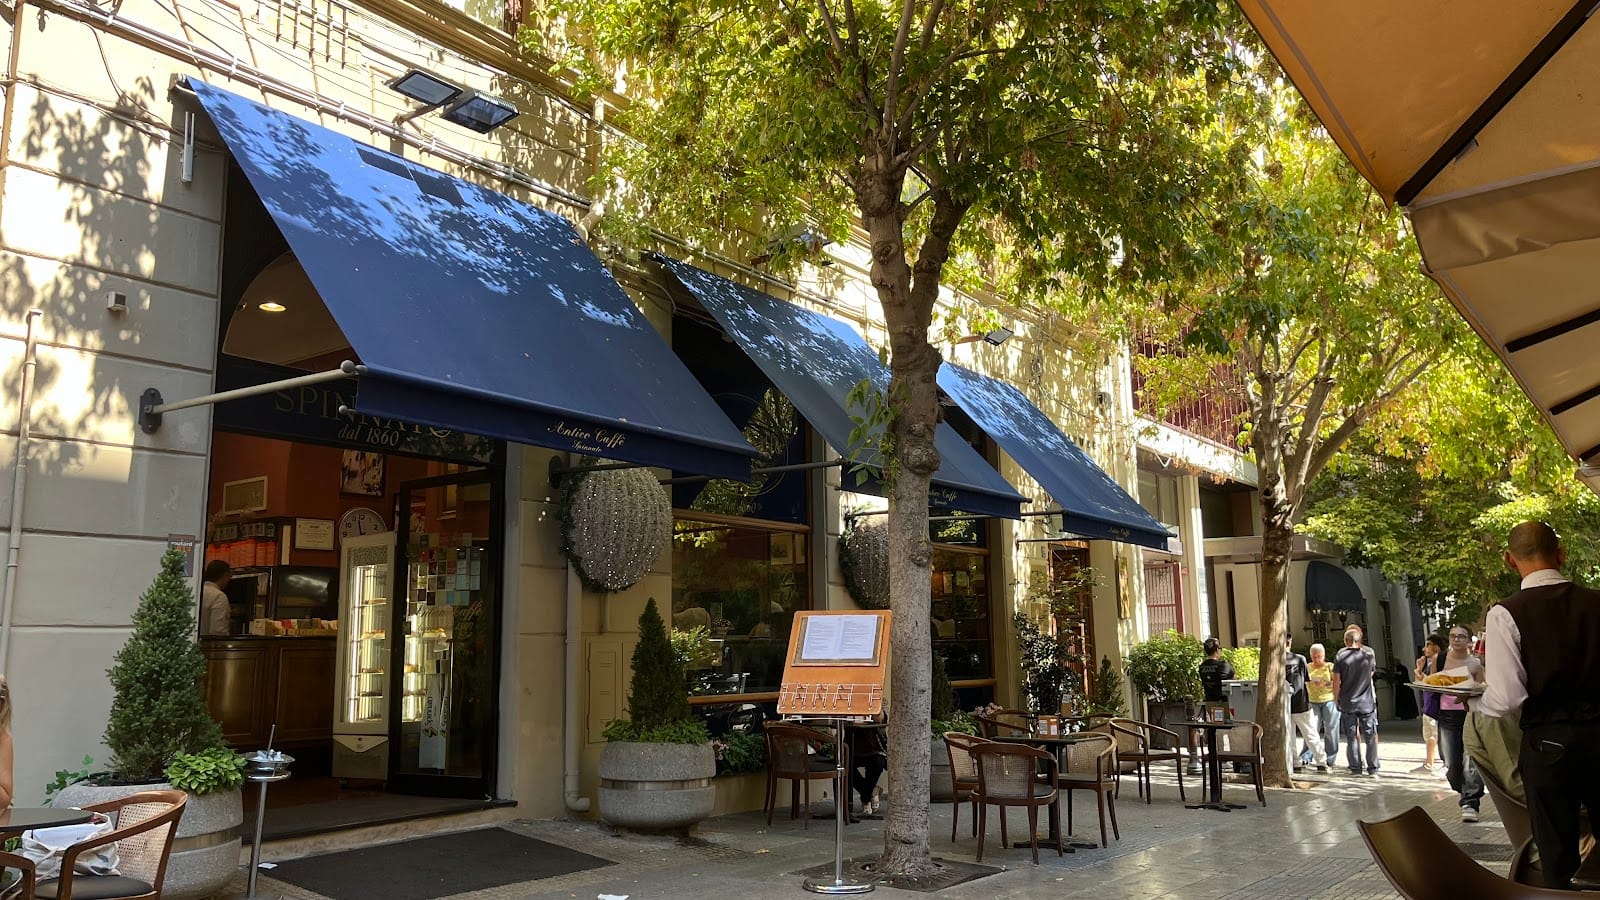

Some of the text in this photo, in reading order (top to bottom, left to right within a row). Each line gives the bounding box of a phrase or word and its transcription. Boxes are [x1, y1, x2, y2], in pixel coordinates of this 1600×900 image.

[337, 423, 401, 447] dal 1860
[547, 421, 590, 440] Antico
